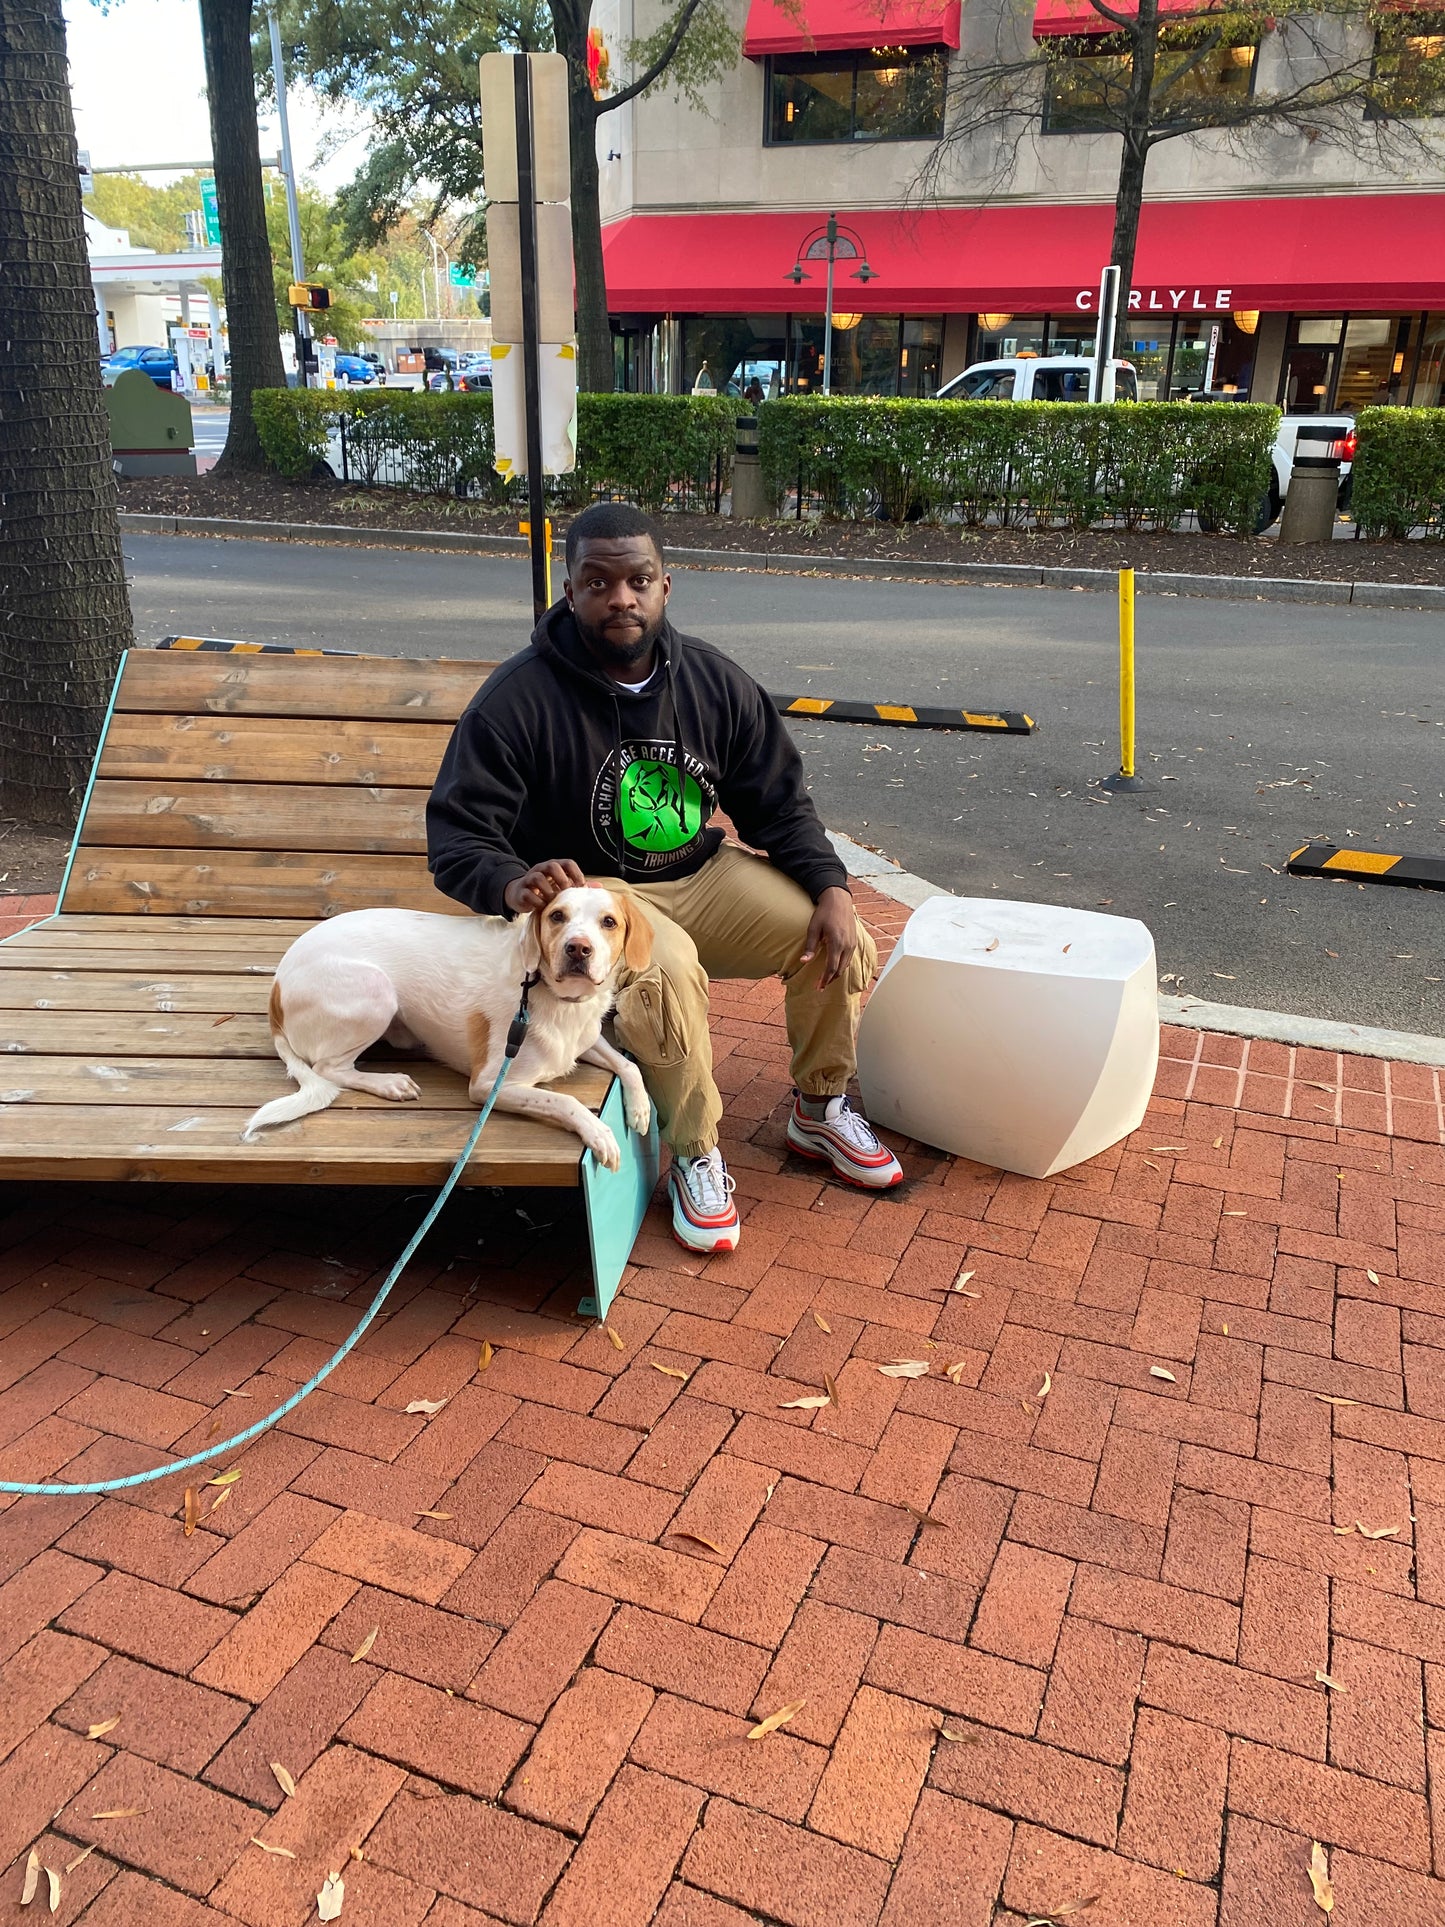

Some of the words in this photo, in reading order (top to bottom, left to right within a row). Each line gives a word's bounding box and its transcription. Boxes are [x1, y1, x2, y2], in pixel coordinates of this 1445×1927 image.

[1075, 290, 1233, 310] CRLYLE
[598, 745, 638, 810] CHALNGE
[641, 745, 704, 777] ACCETED
[643, 844, 694, 868] TRAINING
